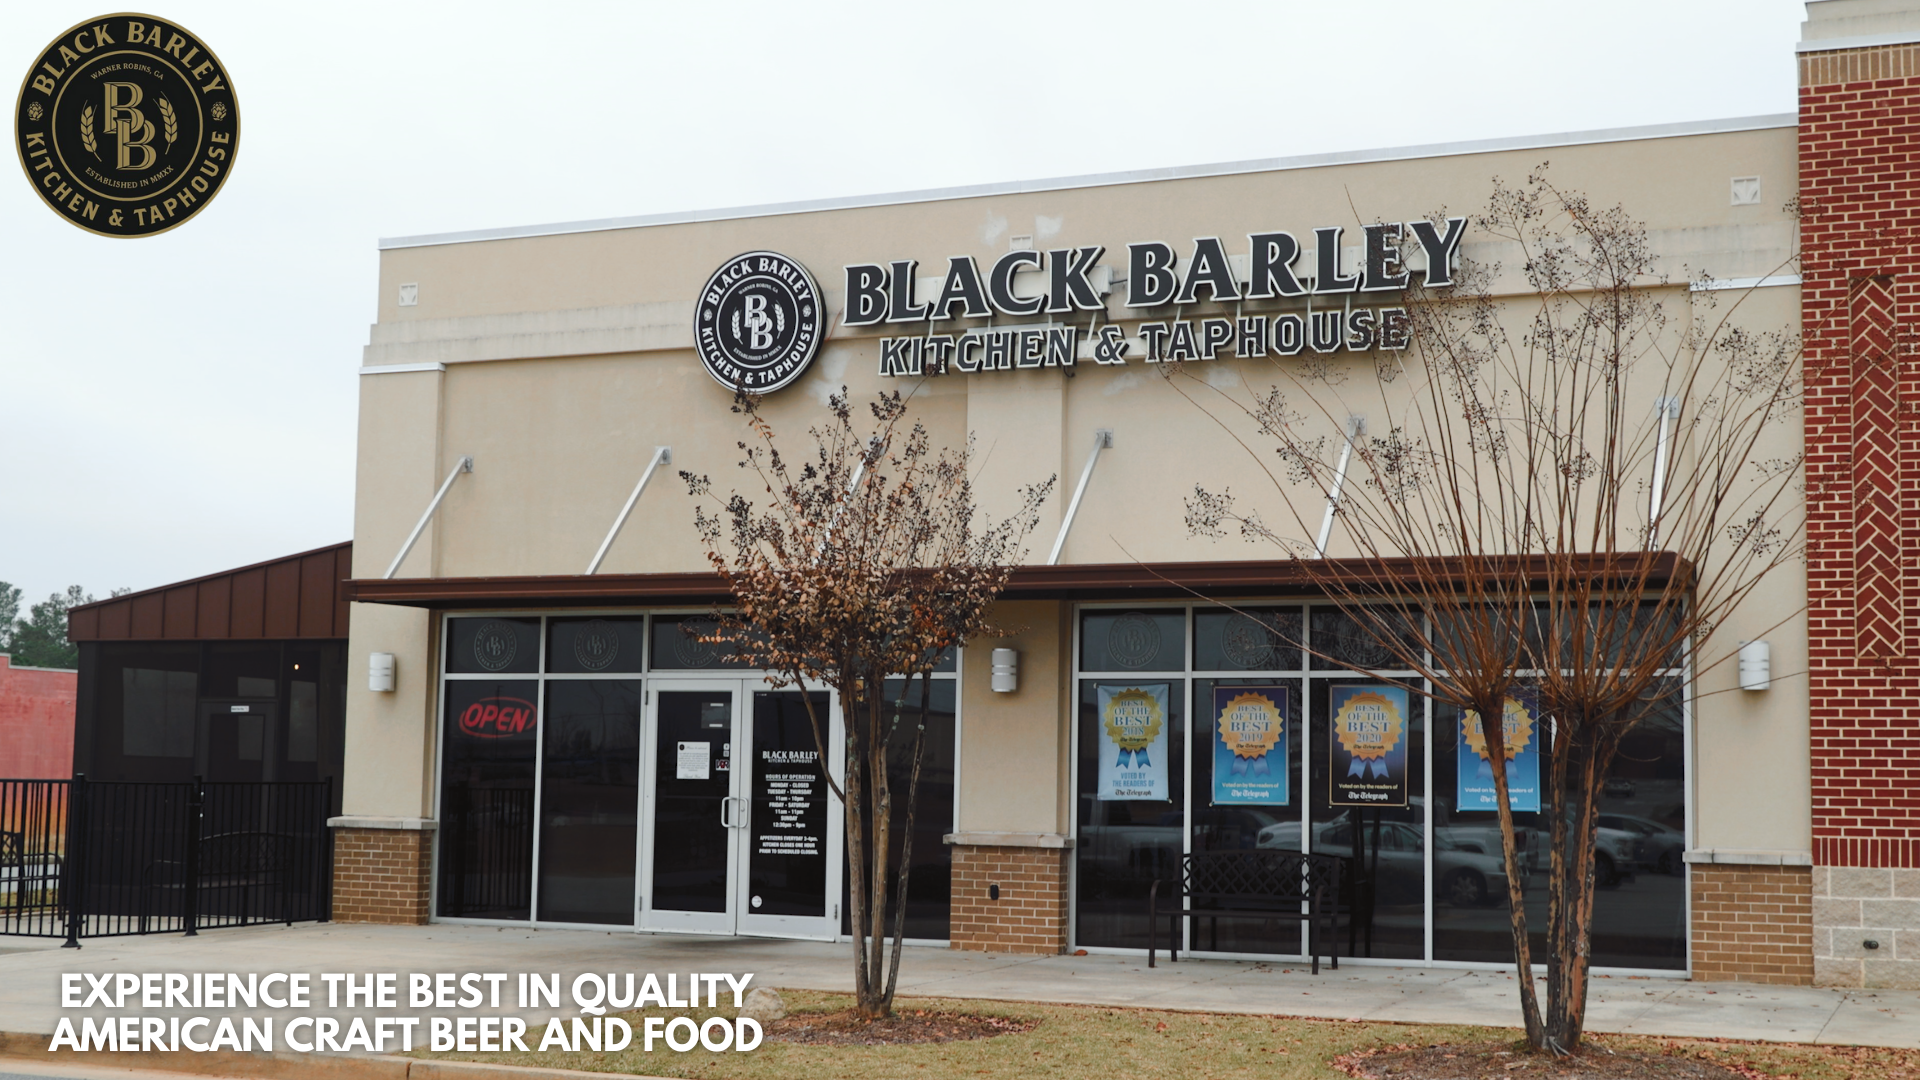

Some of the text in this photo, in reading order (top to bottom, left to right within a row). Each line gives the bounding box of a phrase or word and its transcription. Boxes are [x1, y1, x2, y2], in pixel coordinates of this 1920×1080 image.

[841, 217, 1468, 327] BLACK BARLEY
[706, 257, 811, 306] BLACK BARLEY
[878, 306, 1410, 378] KITCHEN & TAPHOUSE
[702, 322, 813, 384] KITCHEN & TAPHOUSE
[1114, 707, 1150, 715] OF THE
[1230, 712, 1270, 720] OF THE
[1347, 712, 1388, 720] OF THE
[464, 703, 531, 734] OPEN
[1114, 716, 1153, 726] BEST
[1230, 721, 1272, 731] BEST
[1347, 721, 1392, 731] BEST
[1239, 733, 1263, 742] 2019
[1356, 733, 1382, 743] 2020
[762, 751, 819, 760] BLACK BARLEY
[1127, 789, 1152, 797] Telegraph
[1242, 789, 1270, 798] Telegraph
[1348, 791, 1388, 800] The Telegraph
